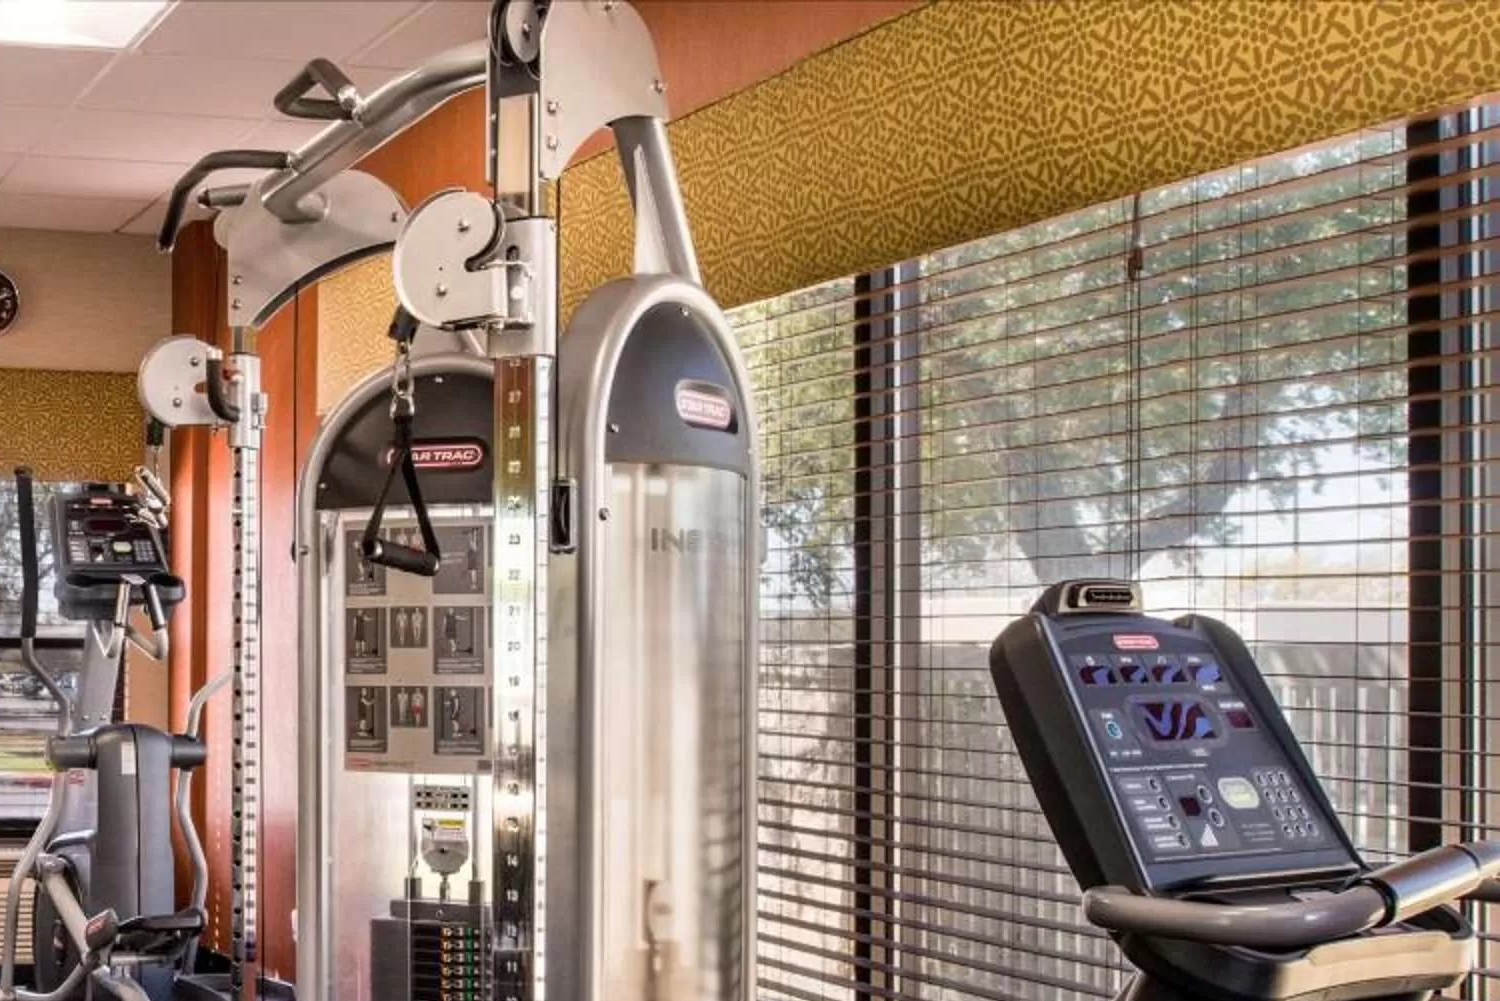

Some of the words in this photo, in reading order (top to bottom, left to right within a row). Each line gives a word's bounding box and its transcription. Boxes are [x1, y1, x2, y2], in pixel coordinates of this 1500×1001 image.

[433, 450, 475, 461] TRAC
[507, 640, 521, 652] 20
[506, 853, 518, 868] 14
[506, 960, 518, 973] 11
